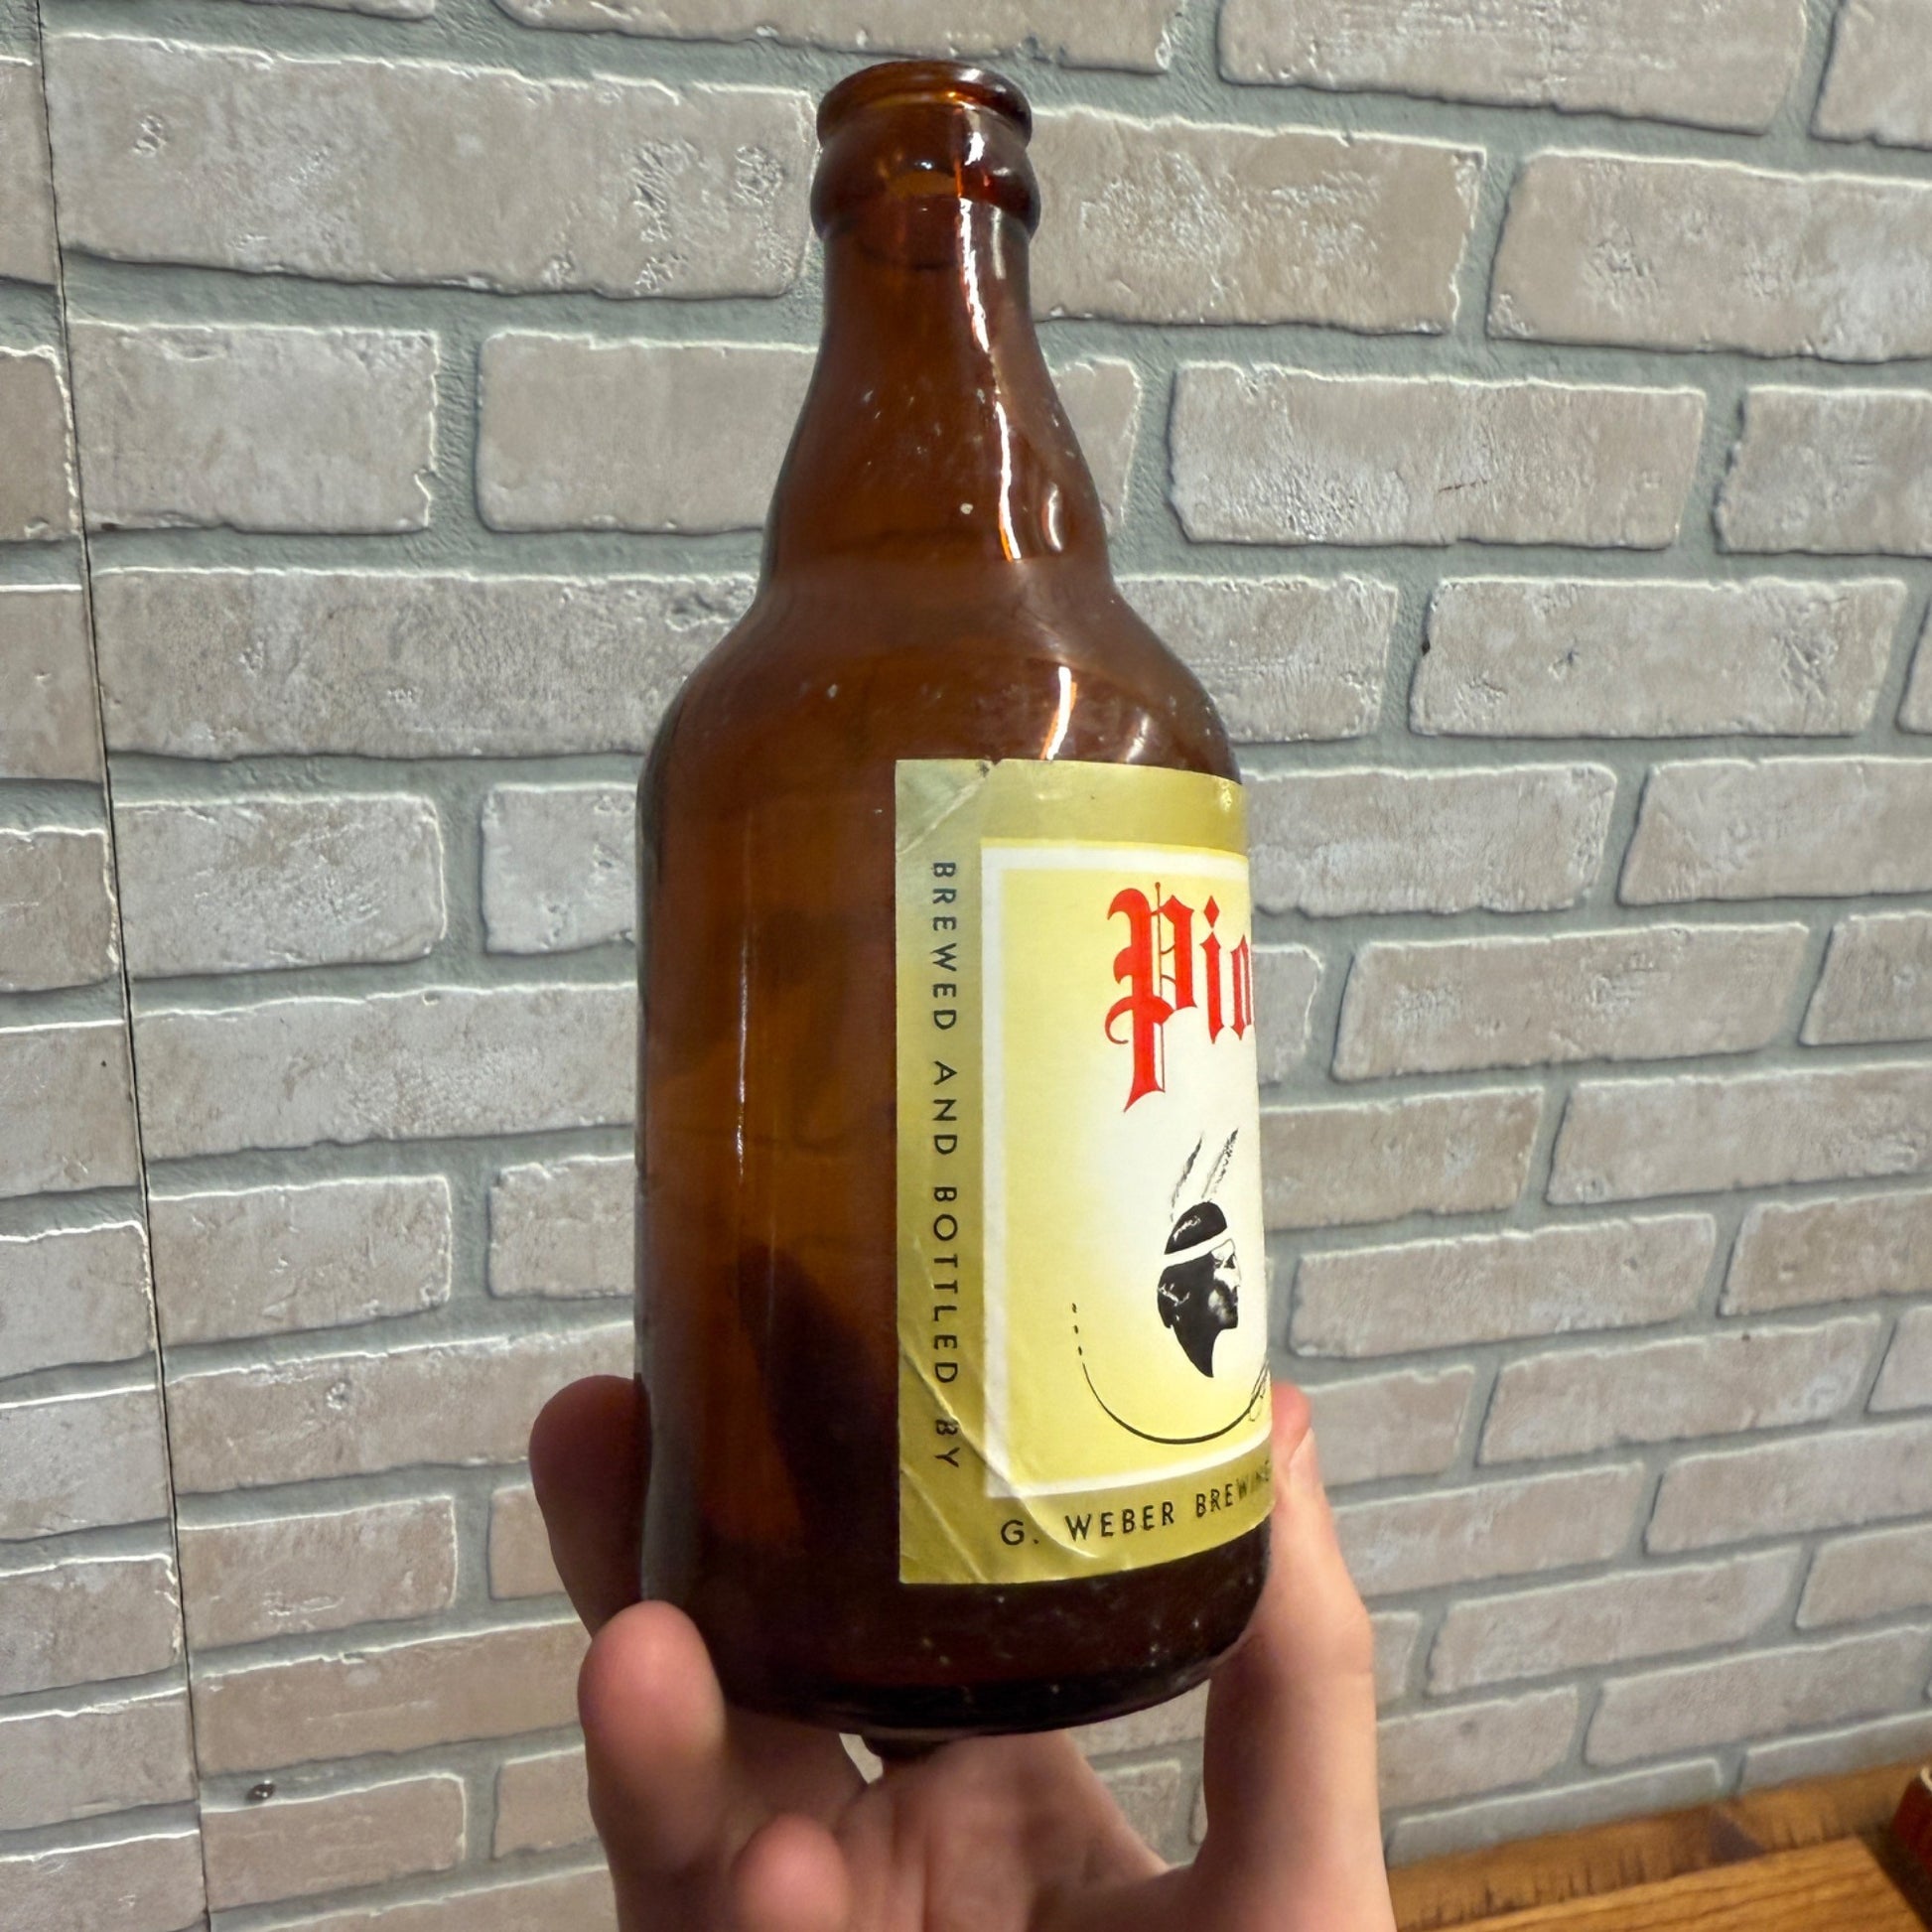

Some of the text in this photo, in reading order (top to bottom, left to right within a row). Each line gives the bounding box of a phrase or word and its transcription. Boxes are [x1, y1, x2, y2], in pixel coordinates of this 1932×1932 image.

[931, 862, 960, 1468] BREWED AND BOTTLED BY
[1000, 1519, 1039, 1547] G.
[1064, 1501, 1174, 1542] WEBER
